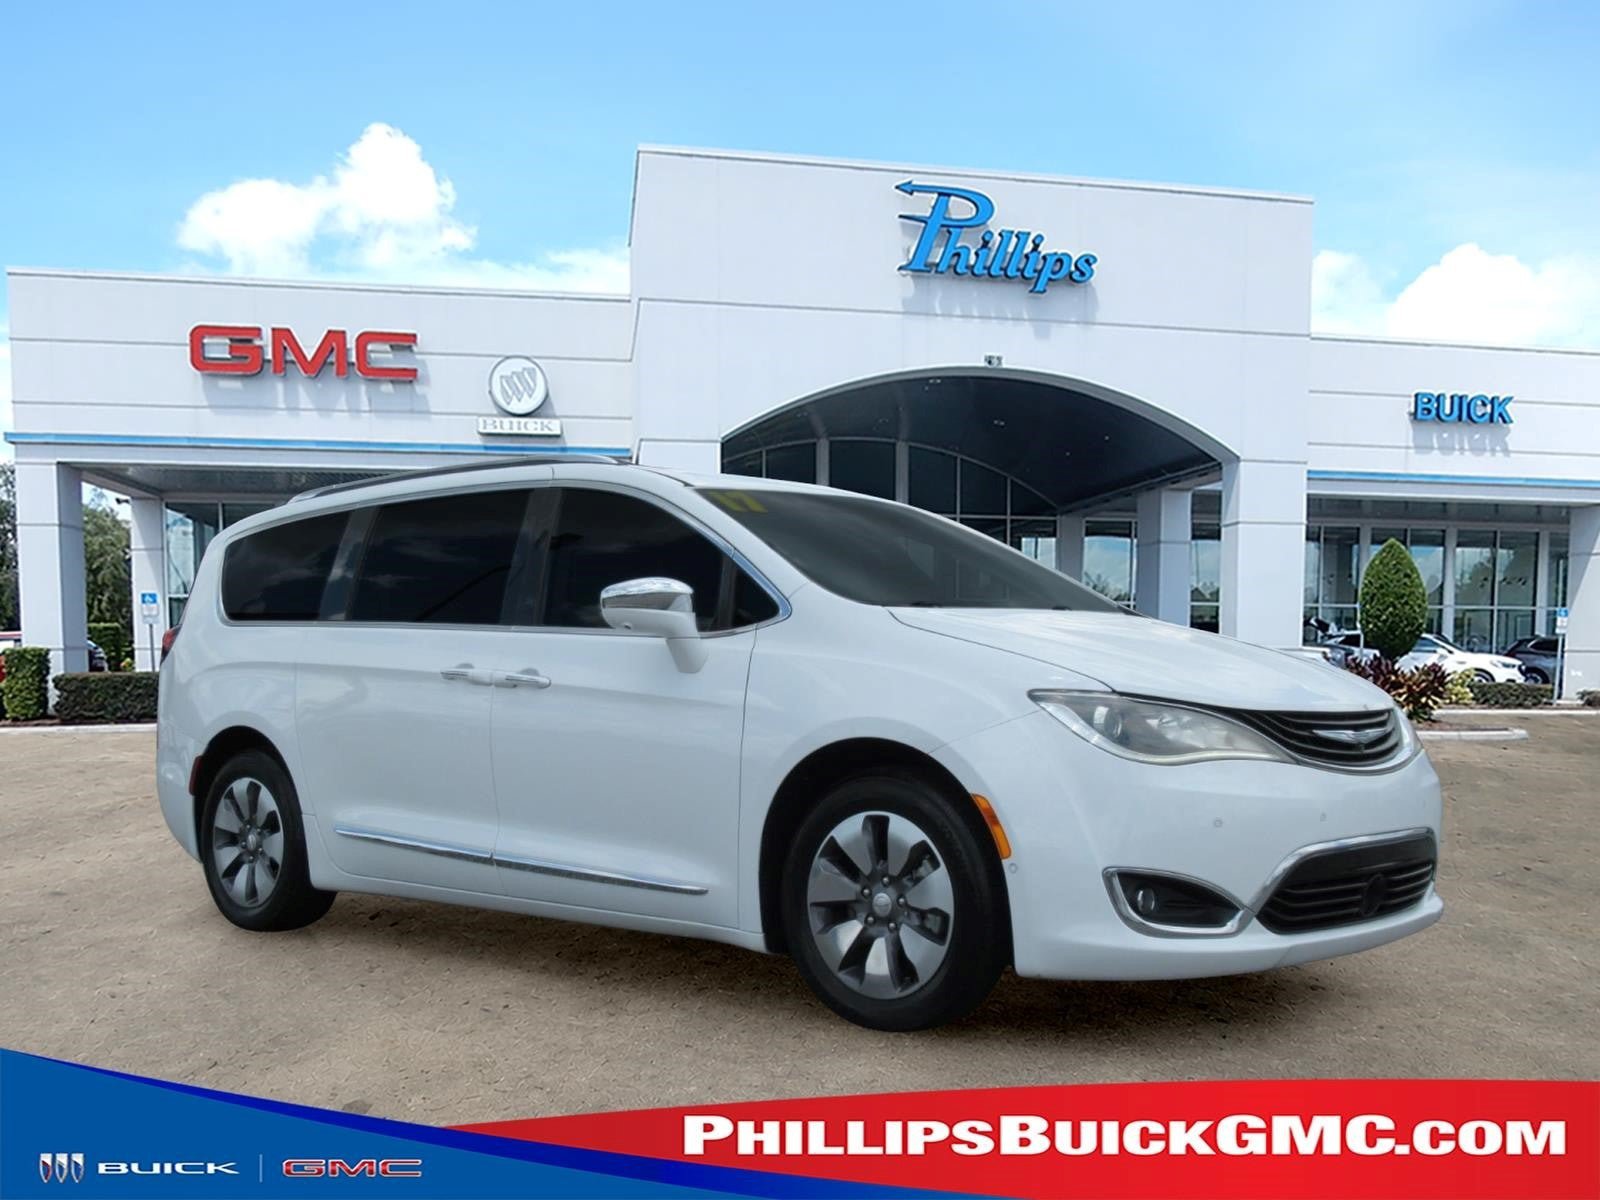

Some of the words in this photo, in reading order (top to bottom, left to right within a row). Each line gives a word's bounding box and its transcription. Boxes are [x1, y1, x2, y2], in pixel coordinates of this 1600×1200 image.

[895, 179, 1098, 293] Phillips
[190, 324, 418, 382] GMC
[481, 418, 554, 432] BUICK
[1413, 391, 1514, 424] BUICK
